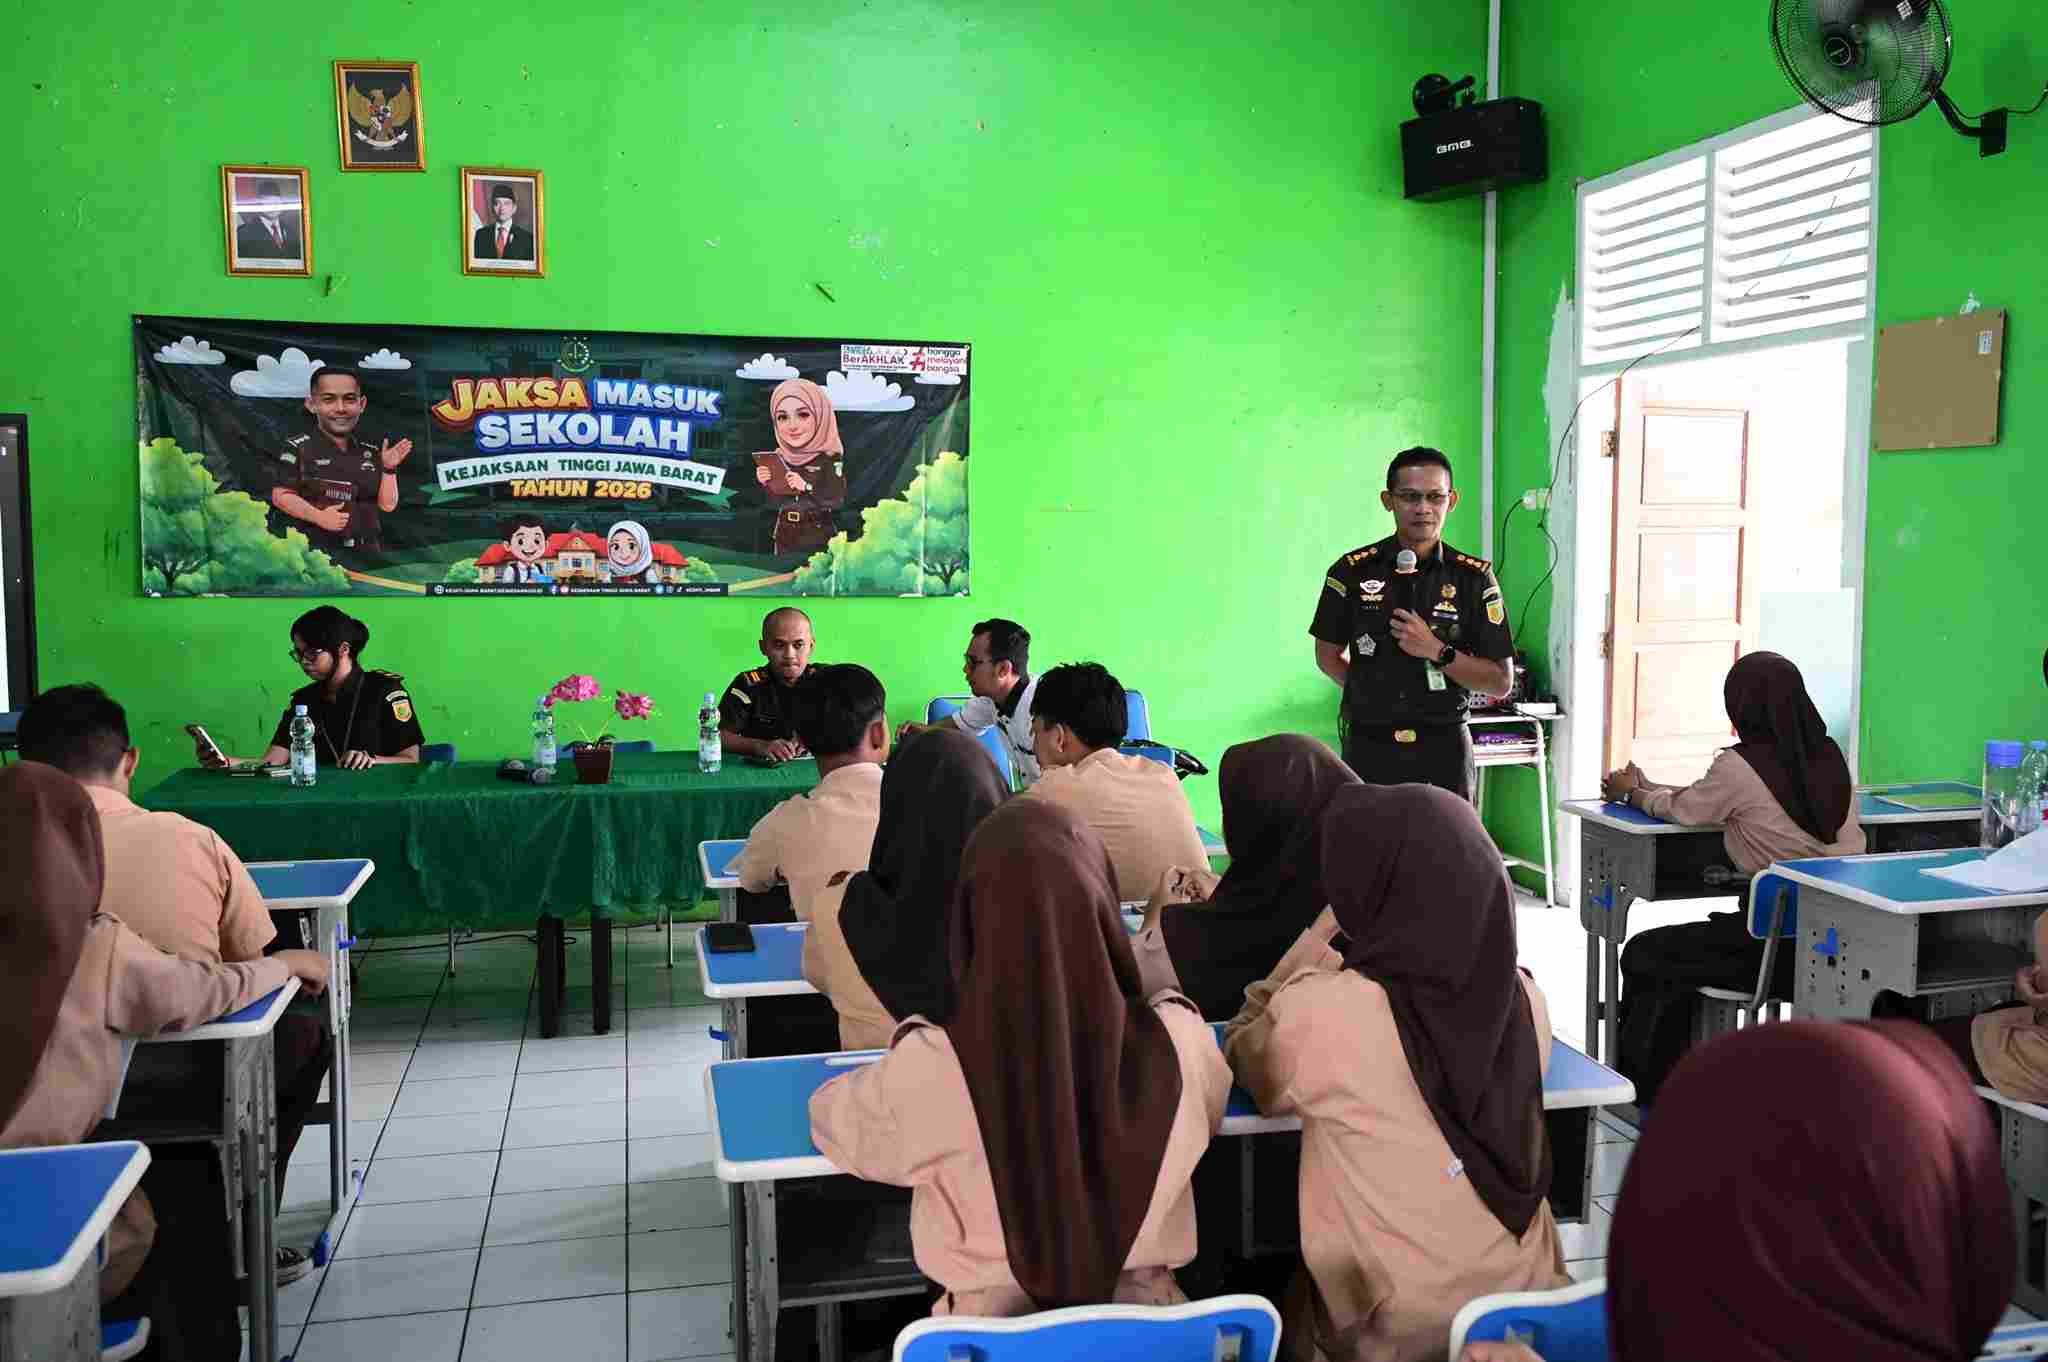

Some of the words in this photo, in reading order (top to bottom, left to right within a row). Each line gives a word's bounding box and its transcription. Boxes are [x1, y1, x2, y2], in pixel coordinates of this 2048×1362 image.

[843, 354, 904, 364] BerAKHLAK
[433, 376, 592, 424] JAKSA
[594, 378, 721, 415] MASUK
[478, 413, 690, 452] SEKOLAH
[445, 459, 548, 482] KEJAKSAAN
[558, 459, 610, 473] TINGGI
[614, 461, 656, 477] JAWA
[660, 465, 718, 486] BARAT
[510, 479, 588, 498] TAHUN
[594, 480, 653, 500] 2026
